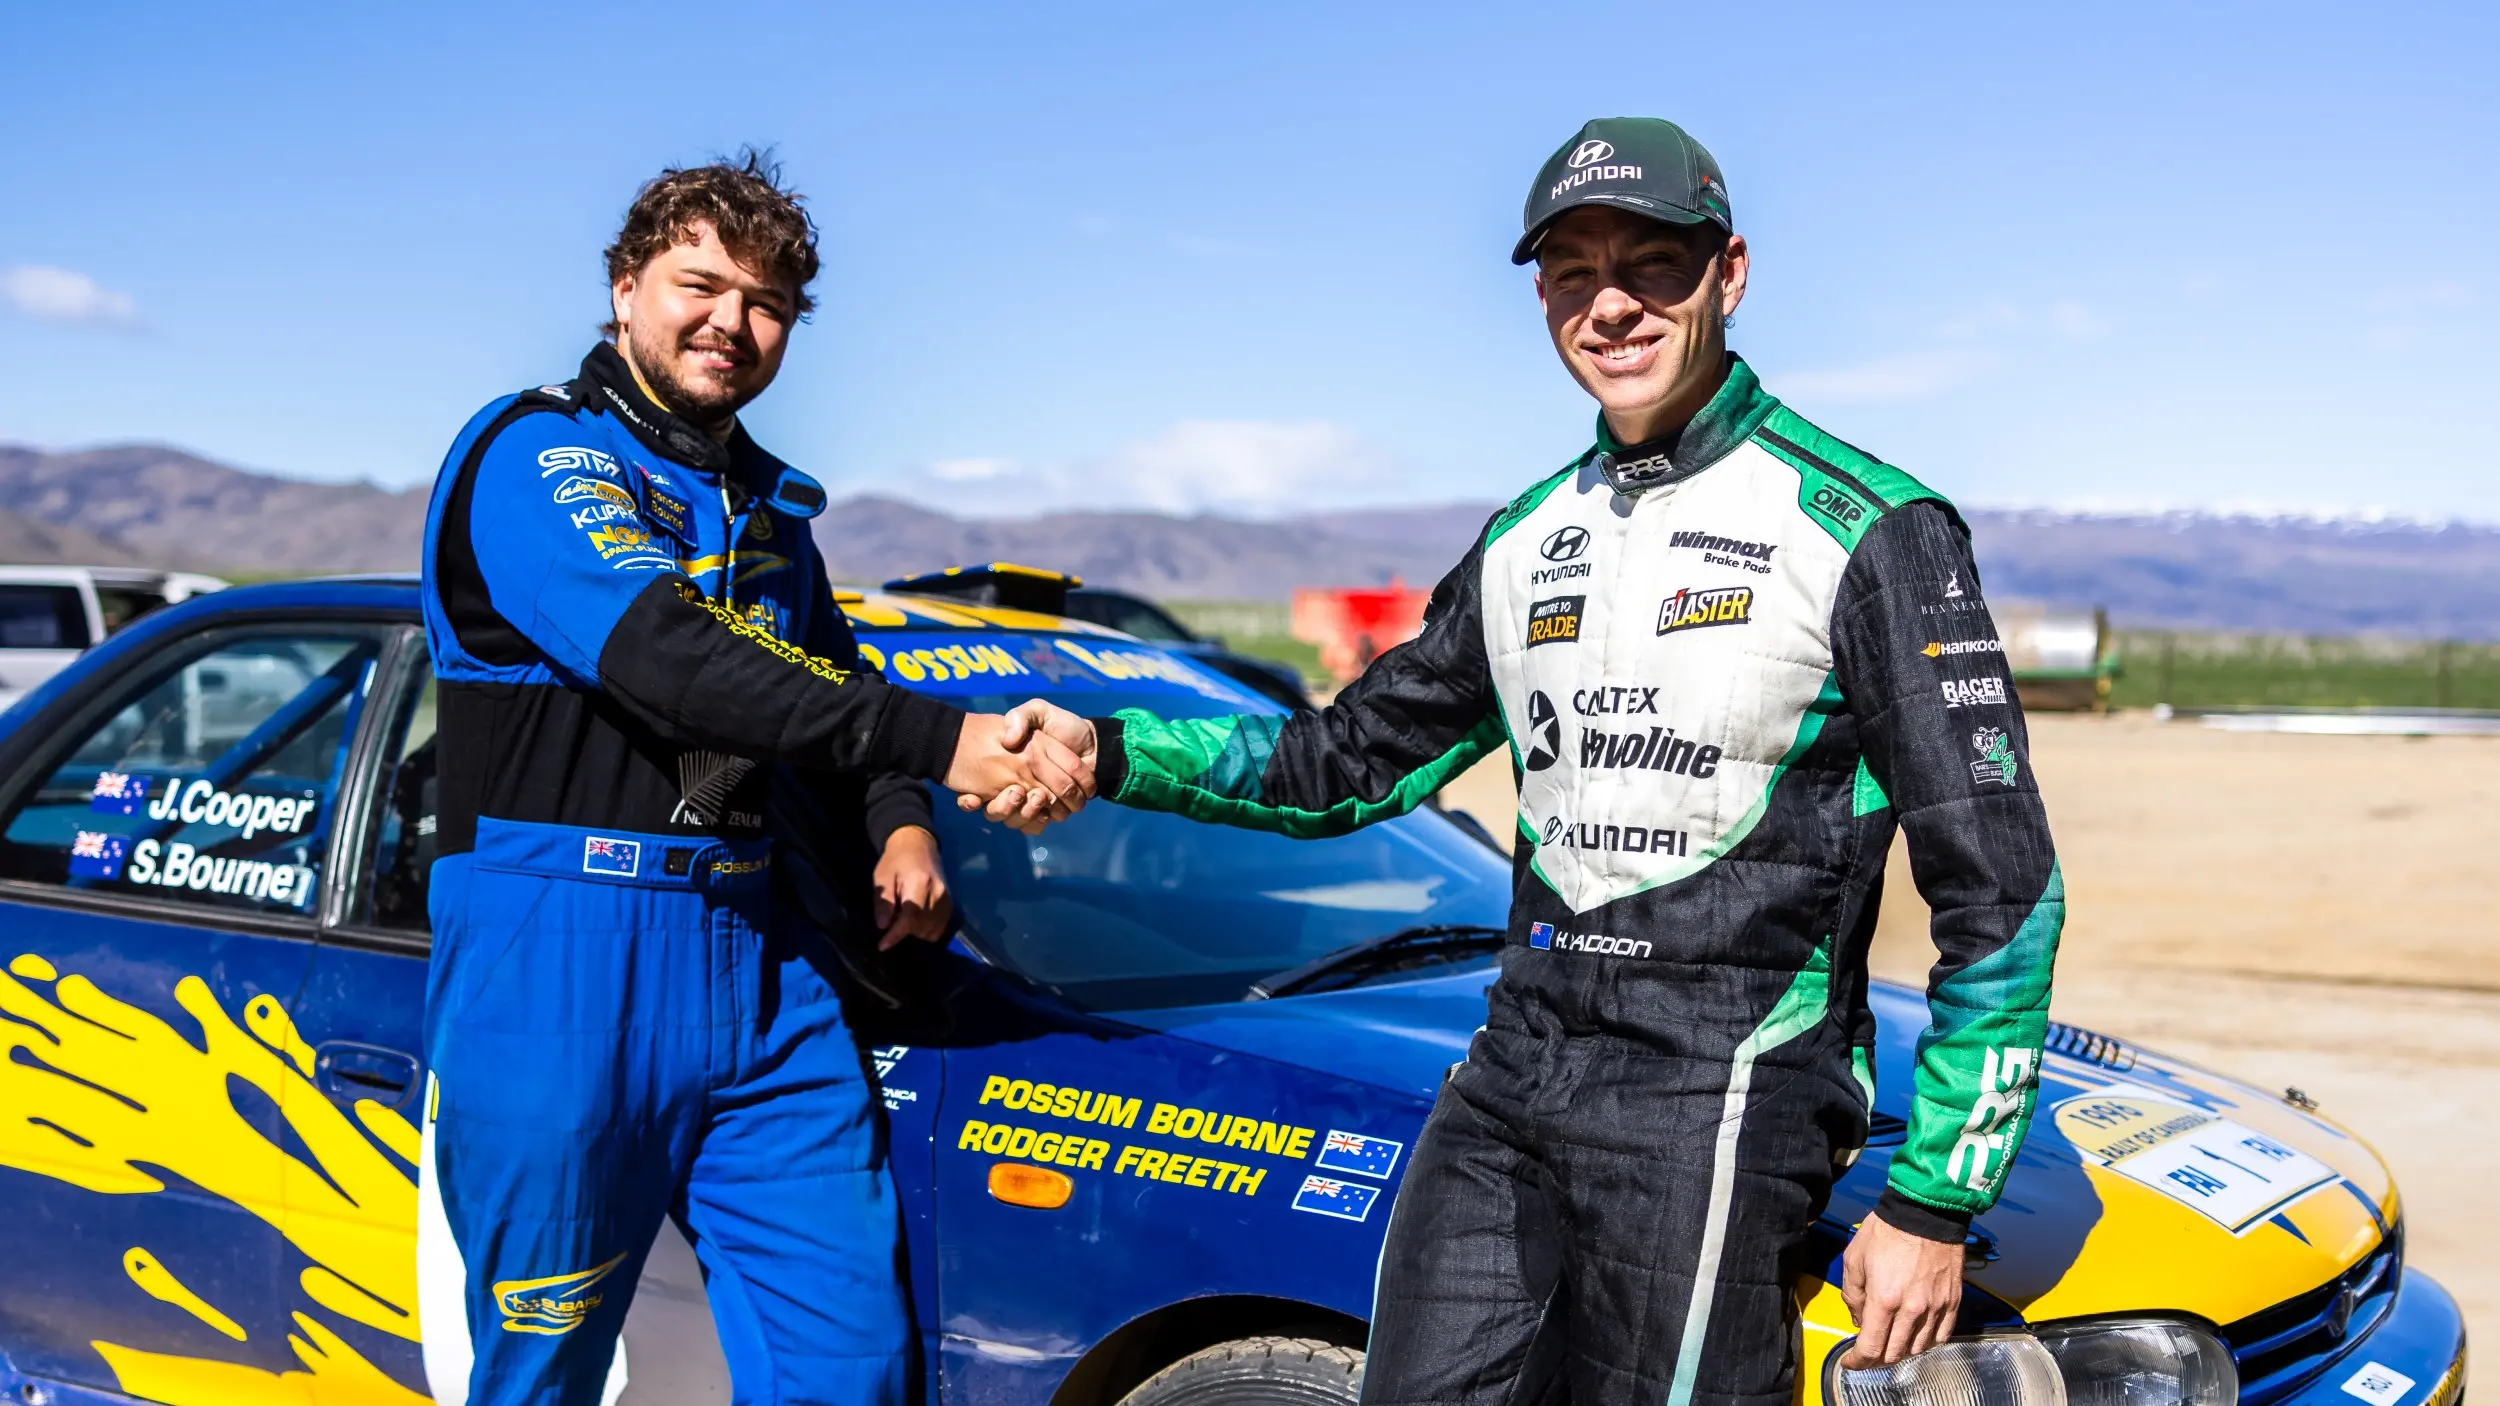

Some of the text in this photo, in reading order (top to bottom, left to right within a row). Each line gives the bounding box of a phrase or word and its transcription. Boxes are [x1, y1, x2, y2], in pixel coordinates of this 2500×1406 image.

[1552, 165, 1642, 200] HYUNDAI
[1616, 454, 1673, 482] PRG
[650, 488, 686, 514] pencer
[1813, 489, 1861, 522] OMP
[1531, 563, 1591, 587] HYUNDAI
[1704, 552, 1772, 574] Brake Pads
[1559, 601, 1572, 612] 10
[1951, 600, 1985, 612] NEVI
[1528, 615, 1578, 643] TRADE
[803, 659, 846, 686] TEAM
[1572, 686, 1661, 716] CALTEX
[1941, 677, 2005, 700] RACER
[149, 777, 315, 840] J.Cooper
[128, 838, 297, 901] S.Bourne
[978, 1074, 1316, 1160] POSSUM BOURNE
[1945, 1045, 2033, 1193] PRG
[2067, 1101, 2144, 1130] 1996
[958, 1118, 1268, 1197] RODGER FREETH
